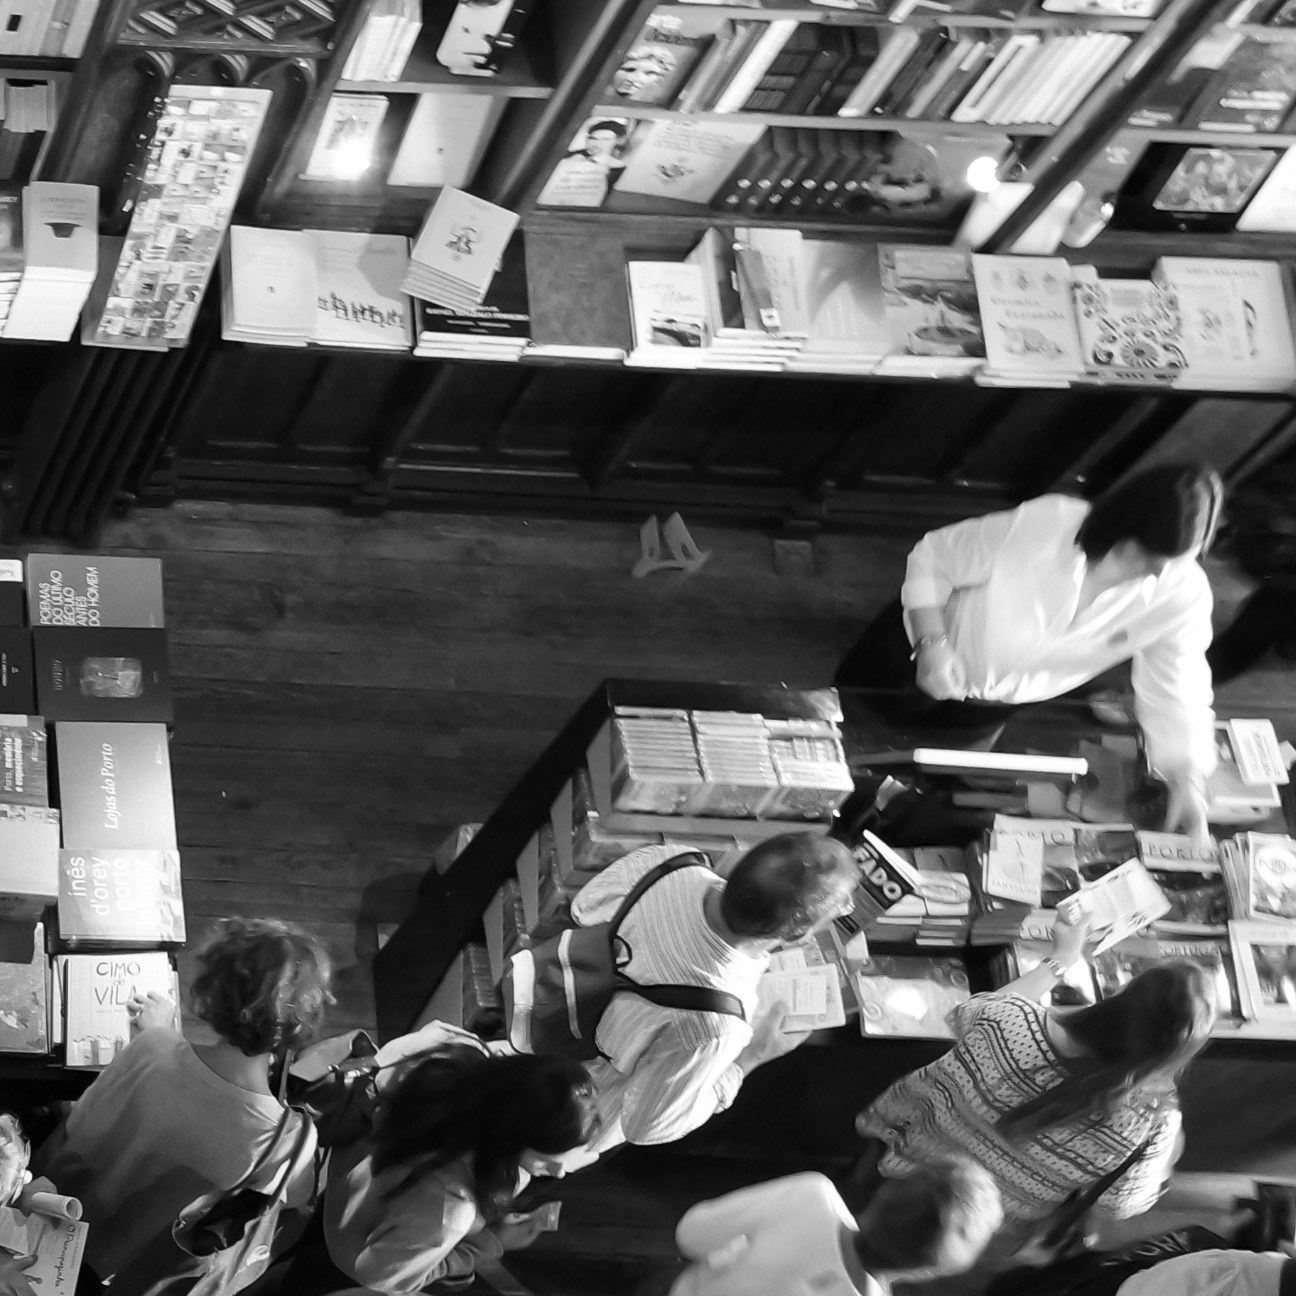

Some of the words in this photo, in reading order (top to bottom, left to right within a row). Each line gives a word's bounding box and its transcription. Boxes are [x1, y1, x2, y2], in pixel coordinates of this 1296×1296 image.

[39, 582, 50, 624] POEMAS
[86, 566, 100, 609] HOMEM
[52, 611, 63, 625] DO
[76, 595, 89, 626] ANTES
[88, 611, 100, 626] DO
[100, 742, 115, 777] Porto
[102, 779, 117, 794] do
[103, 794, 122, 830] Lojas
[66, 856, 87, 897] inês
[89, 856, 111, 916] d'orey
[111, 857, 135, 911] porto
[852, 851, 907, 903] FADO
[95, 961, 141, 978] CIMO
